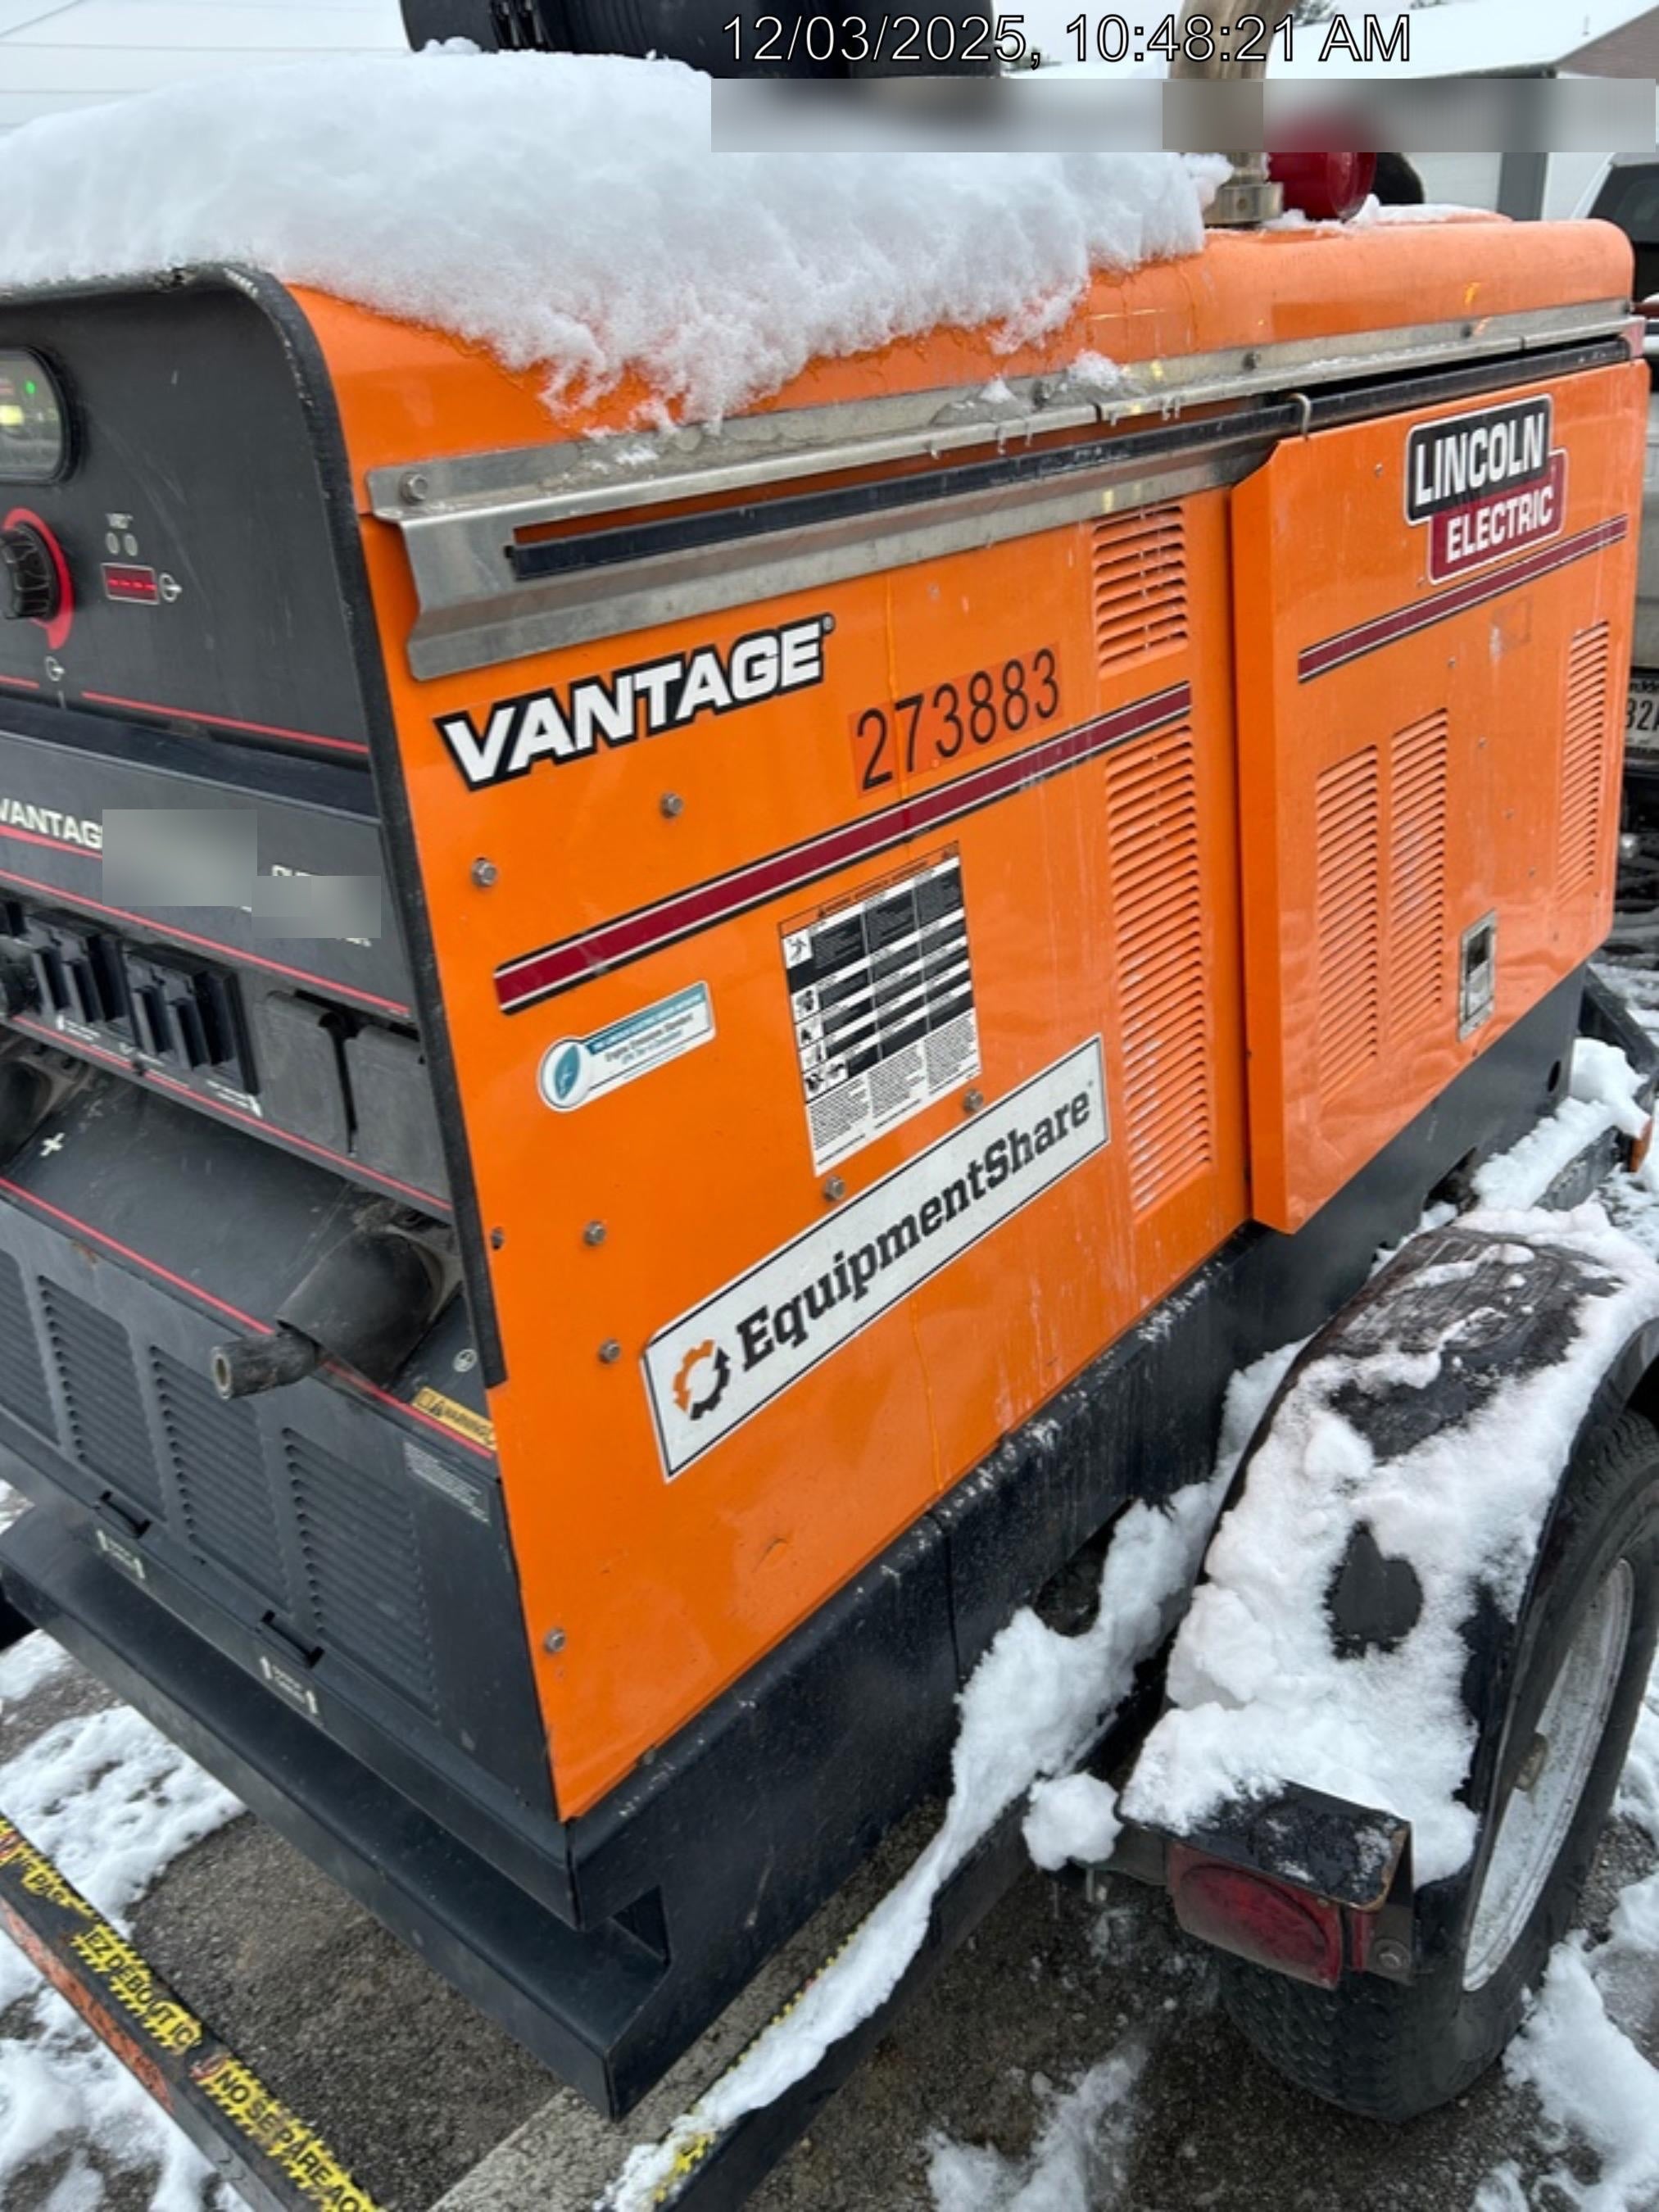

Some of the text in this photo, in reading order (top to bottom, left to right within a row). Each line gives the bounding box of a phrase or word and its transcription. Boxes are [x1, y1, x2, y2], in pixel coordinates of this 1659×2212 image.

[1415, 413, 1545, 506] LINCOLN
[1446, 486, 1555, 564] ELECTRIC
[434, 614, 824, 790] VANTAGE
[857, 648, 1059, 790] 273883
[736, 1089, 1090, 1372] EquipmentShare
[215, 2070, 250, 2104] NO
[247, 2100, 279, 2132] SE
